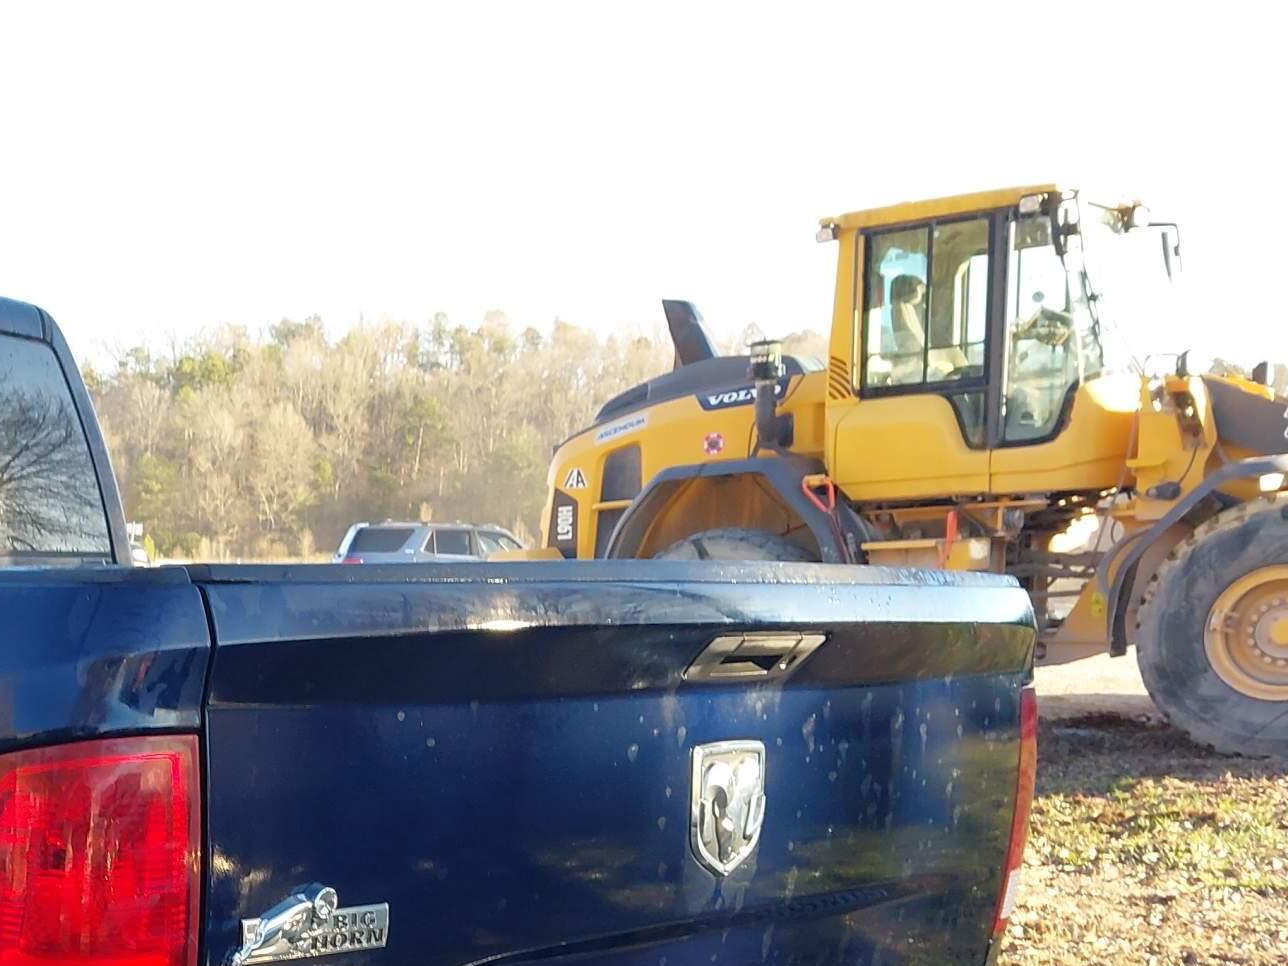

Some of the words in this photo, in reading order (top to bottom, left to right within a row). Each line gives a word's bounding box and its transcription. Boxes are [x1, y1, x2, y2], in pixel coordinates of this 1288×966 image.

[557, 505, 573, 540] L90H
[332, 910, 377, 931] BIG
[312, 928, 384, 950] HORN
